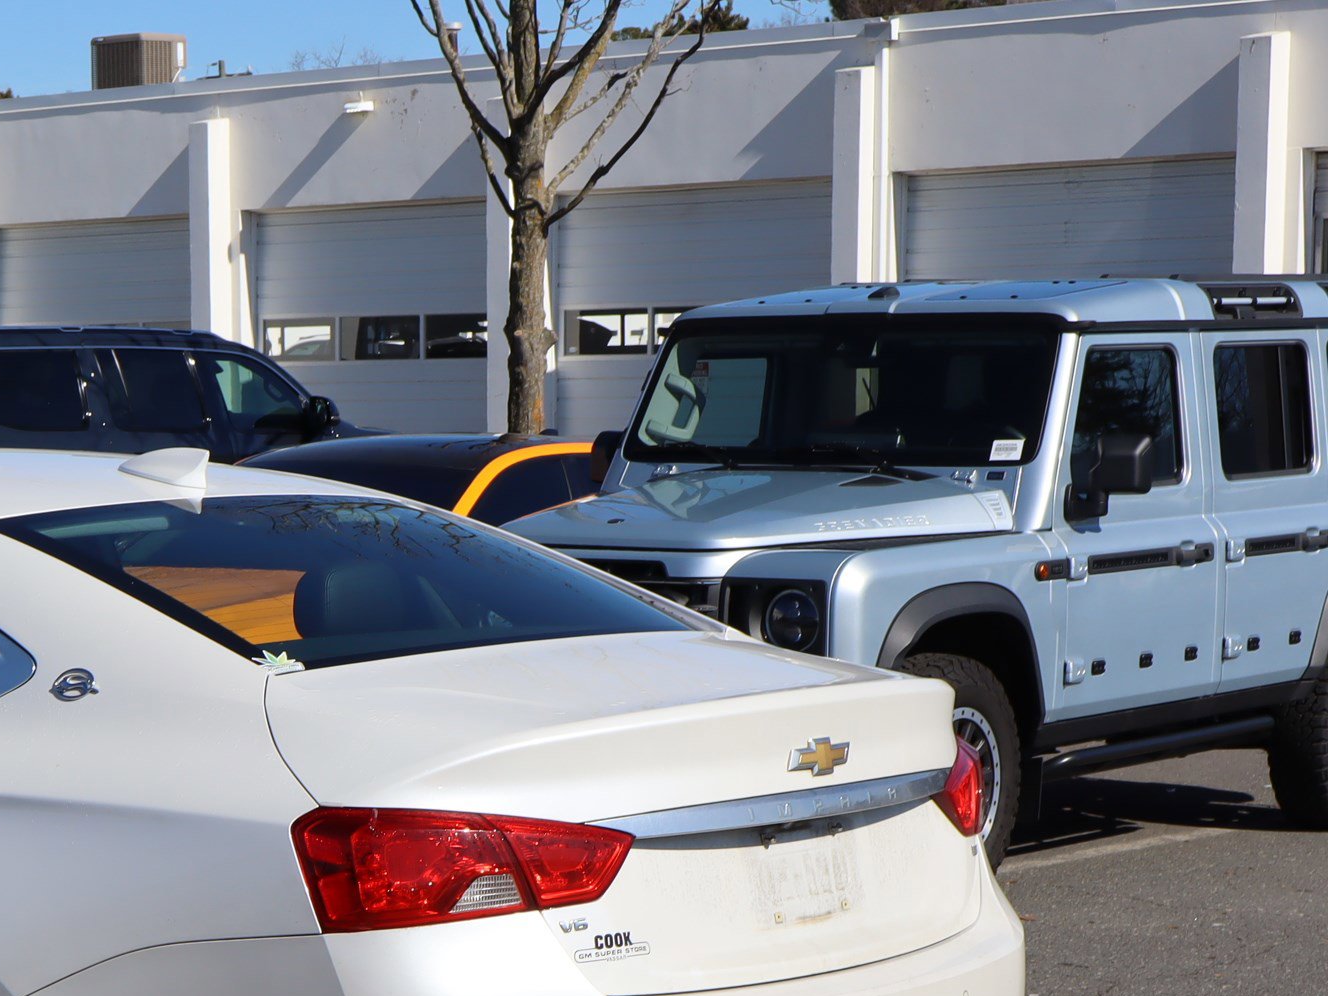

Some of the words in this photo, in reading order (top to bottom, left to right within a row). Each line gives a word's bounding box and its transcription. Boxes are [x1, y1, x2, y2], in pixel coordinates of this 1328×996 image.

[558, 917, 589, 934] V6
[594, 931, 633, 949] COOK
[594, 949, 623, 958] SUPER
[625, 945, 648, 954] STORE
